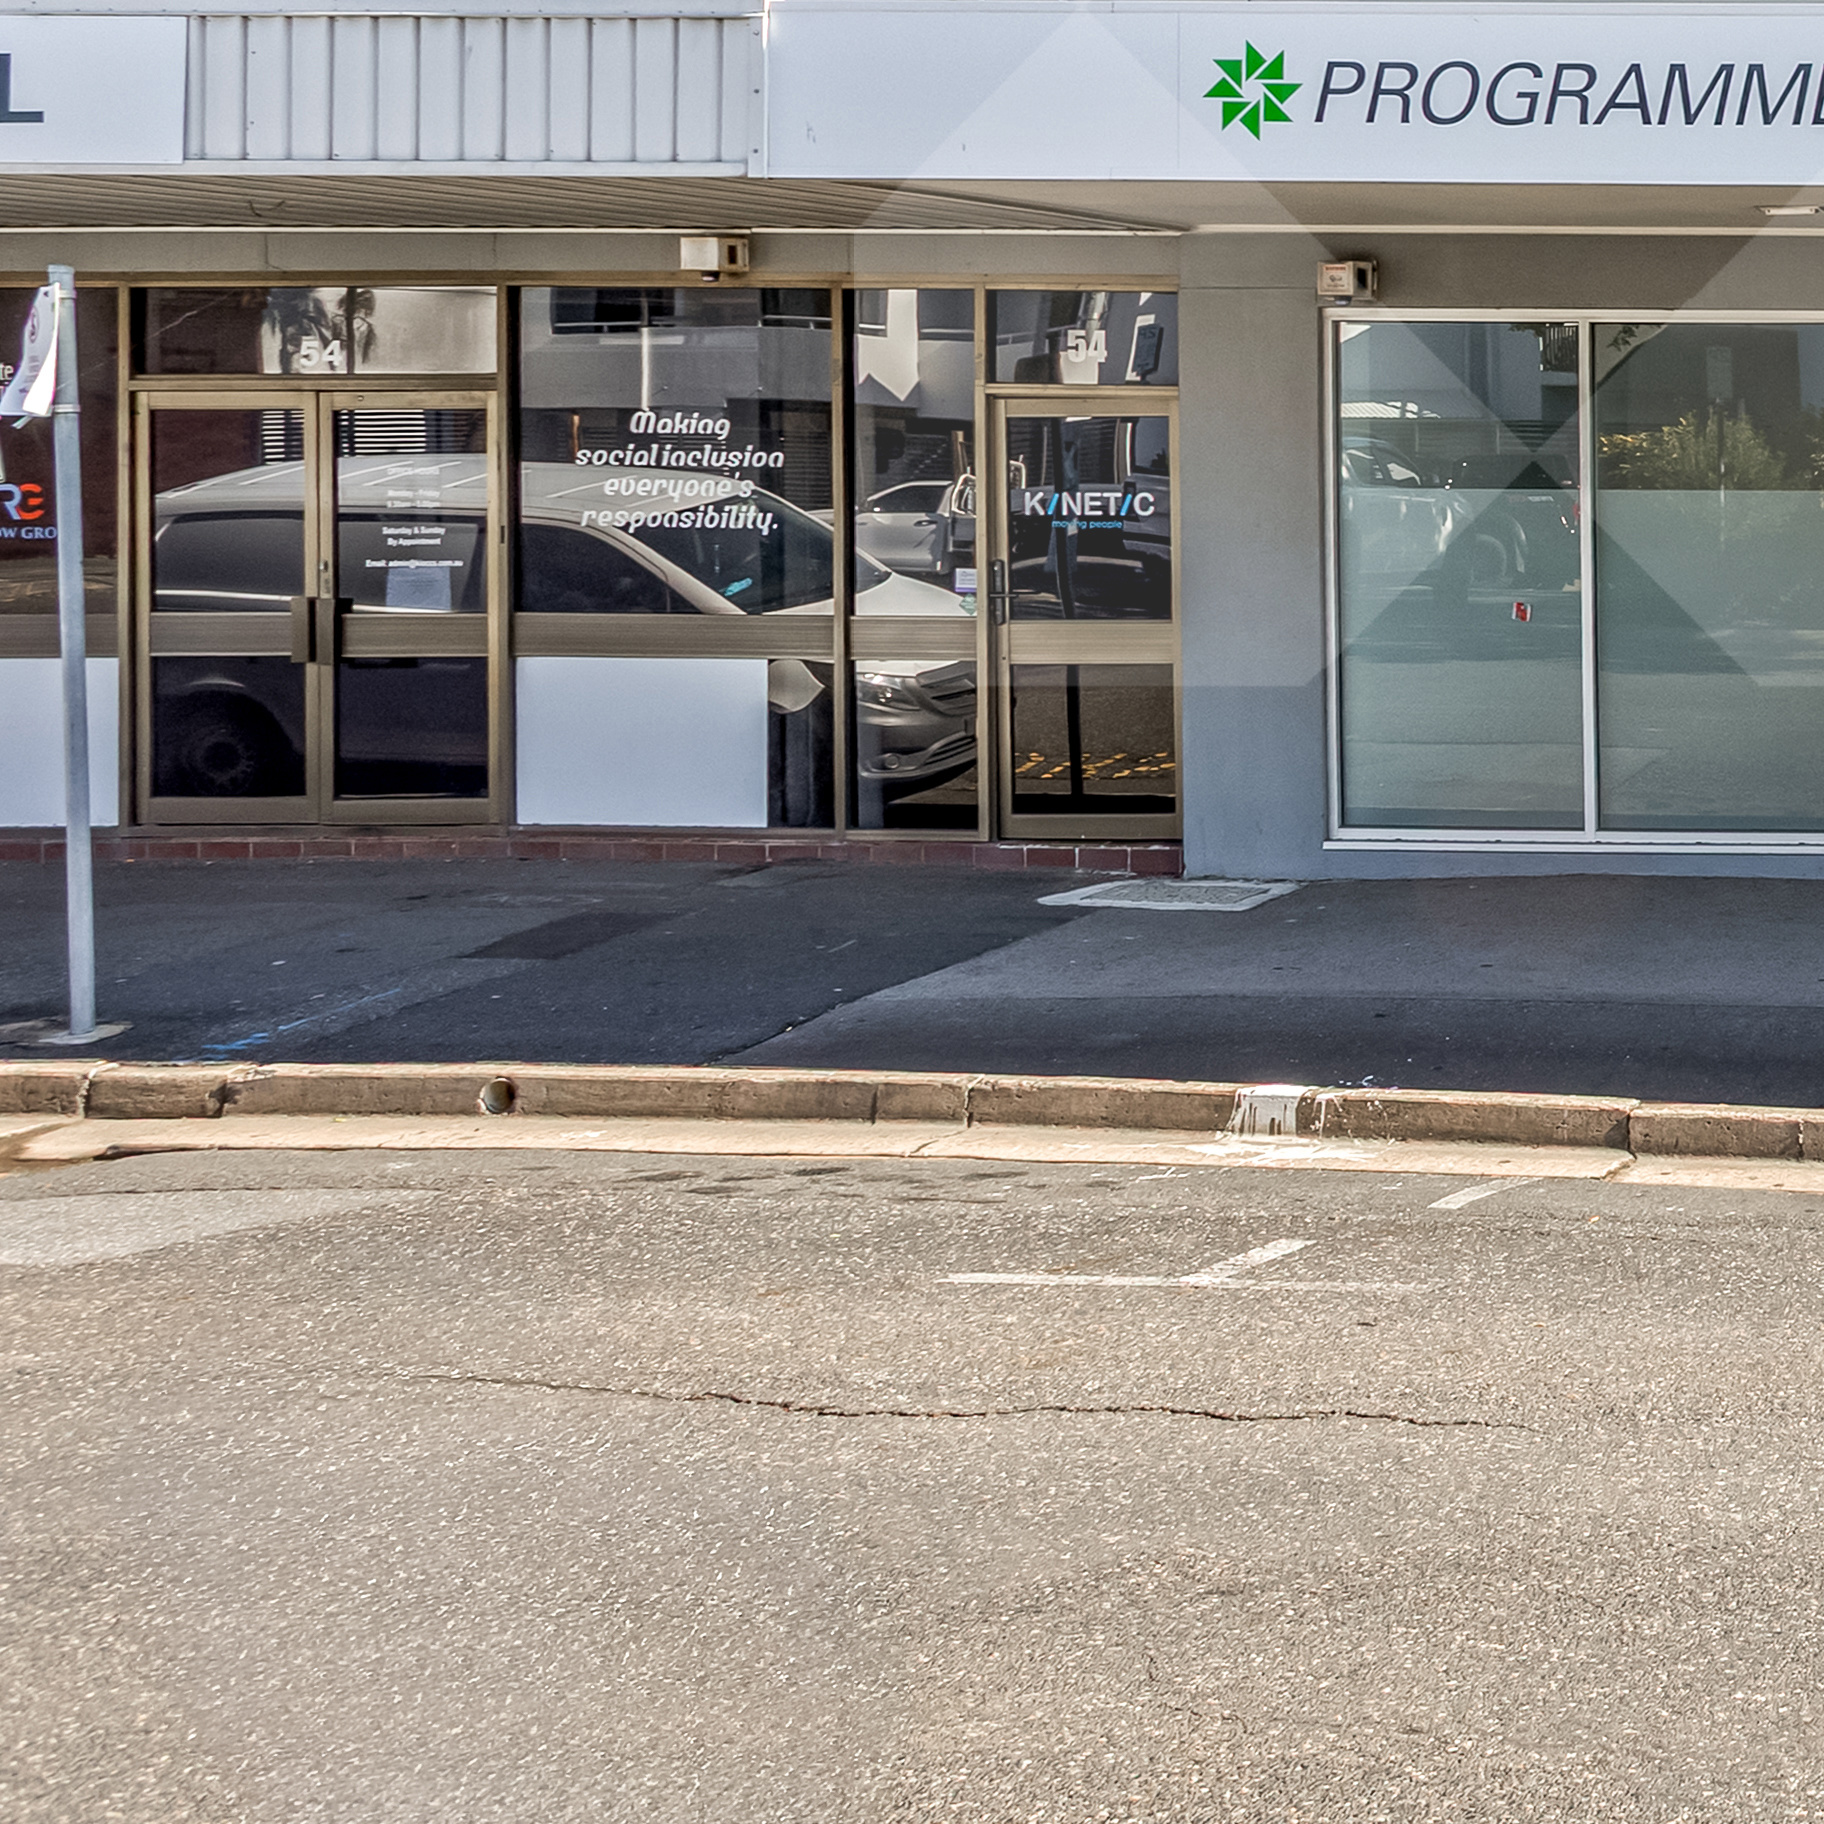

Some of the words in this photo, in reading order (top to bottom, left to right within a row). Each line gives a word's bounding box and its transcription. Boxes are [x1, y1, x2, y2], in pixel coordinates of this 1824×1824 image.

[299, 335, 343, 367] 54
[1066, 329, 1107, 363] 54
[630, 411, 731, 440] Making
[575, 443, 658, 466] social
[661, 444, 785, 468] inclusion
[603, 472, 755, 503] everyone's
[580, 505, 778, 536] responsibility.
[1052, 520, 1087, 530] moving
[1089, 520, 1123, 529] people
